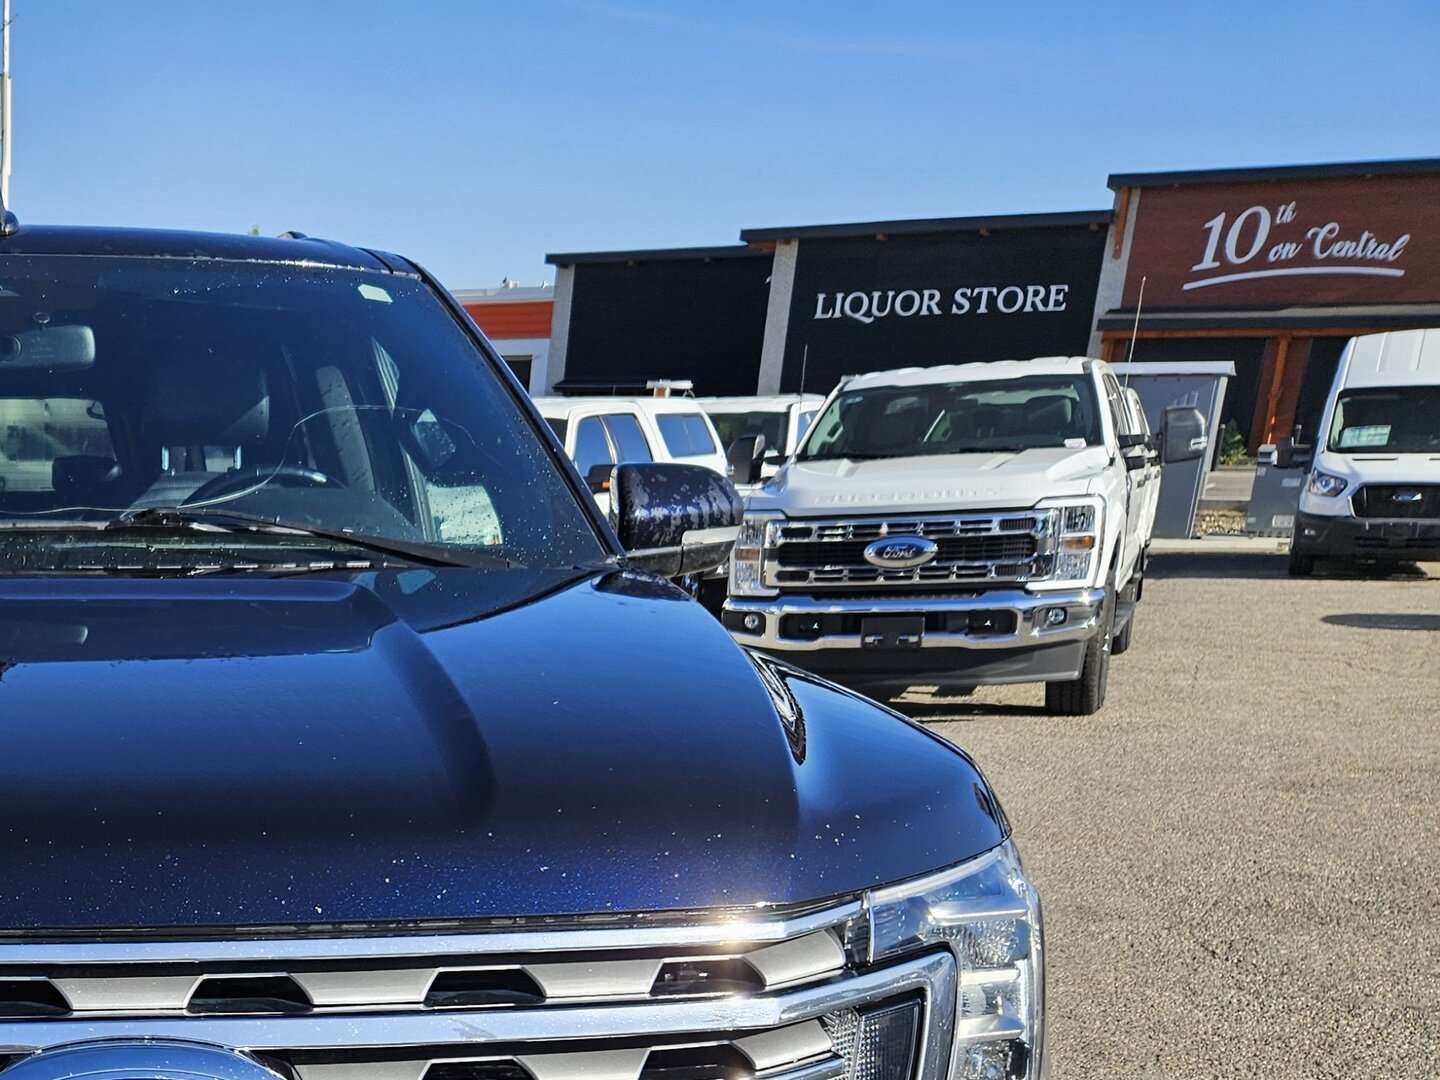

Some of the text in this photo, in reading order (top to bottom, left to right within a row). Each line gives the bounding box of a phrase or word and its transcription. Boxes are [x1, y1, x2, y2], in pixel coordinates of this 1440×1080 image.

[1268, 240, 1303, 263] on
[1305, 222, 1410, 262] Central
[814, 284, 1069, 324] LIQUOR STORE
